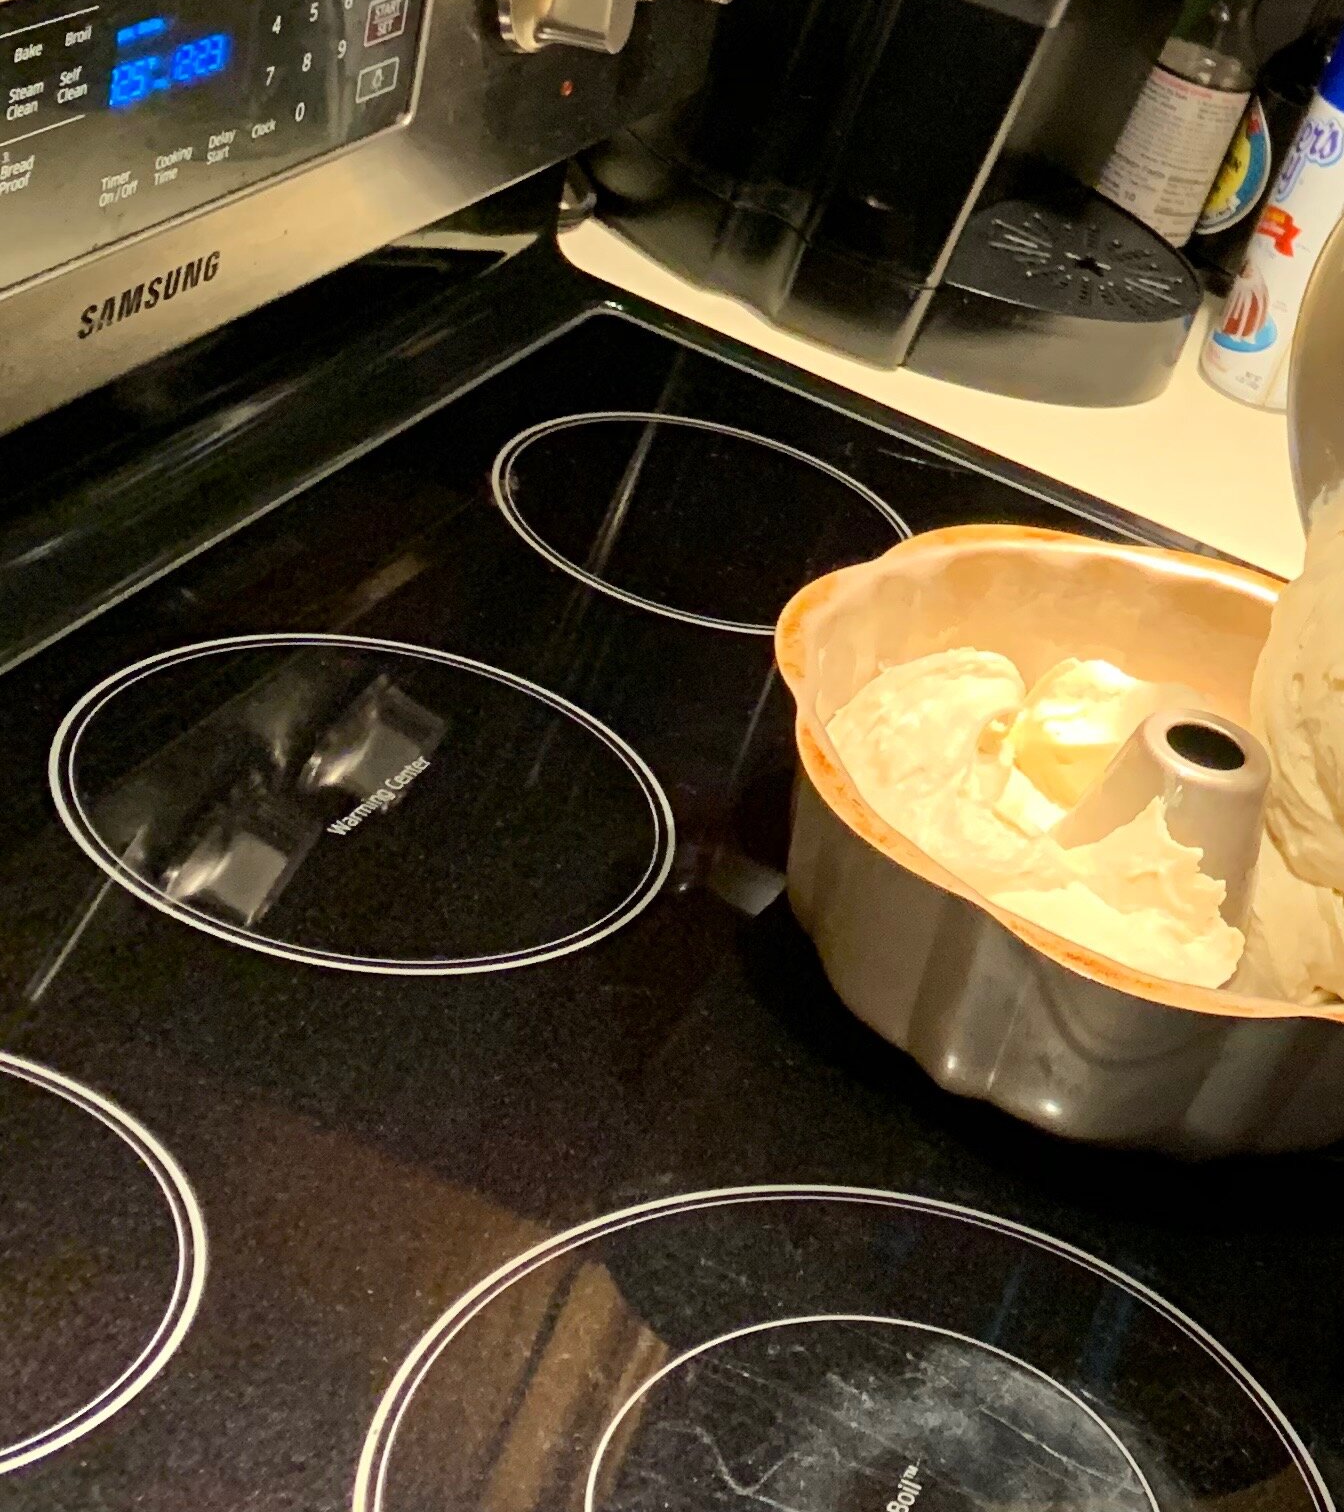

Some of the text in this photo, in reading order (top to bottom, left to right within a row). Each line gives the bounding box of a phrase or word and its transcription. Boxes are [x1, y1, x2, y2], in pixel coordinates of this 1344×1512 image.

[309, 2, 319, 22] 5
[272, 15, 282, 35] 4
[377, 18, 394, 37] SET
[64, 25, 93, 47] Broil
[14, 43, 44, 64] Bake
[337, 39, 347, 59] 9
[302, 52, 312, 72] 8
[59, 65, 83, 87] Self
[266, 66, 275, 86] 7
[8, 81, 45, 104] Steam
[57, 83, 88, 104] Clean
[6, 100, 39, 121] Clean
[295, 102, 305, 122] 0
[208, 129, 237, 150] Delay
[251, 119, 277, 139] Clock
[155, 146, 194, 170] Cooking
[206, 145, 230, 165] Start
[0, 154, 35, 180] Bread
[154, 167, 178, 187] Time
[101, 170, 132, 192] Timer
[76, 250, 221, 341] SAMSUNG
[326, 755, 432, 837] Warming Center
